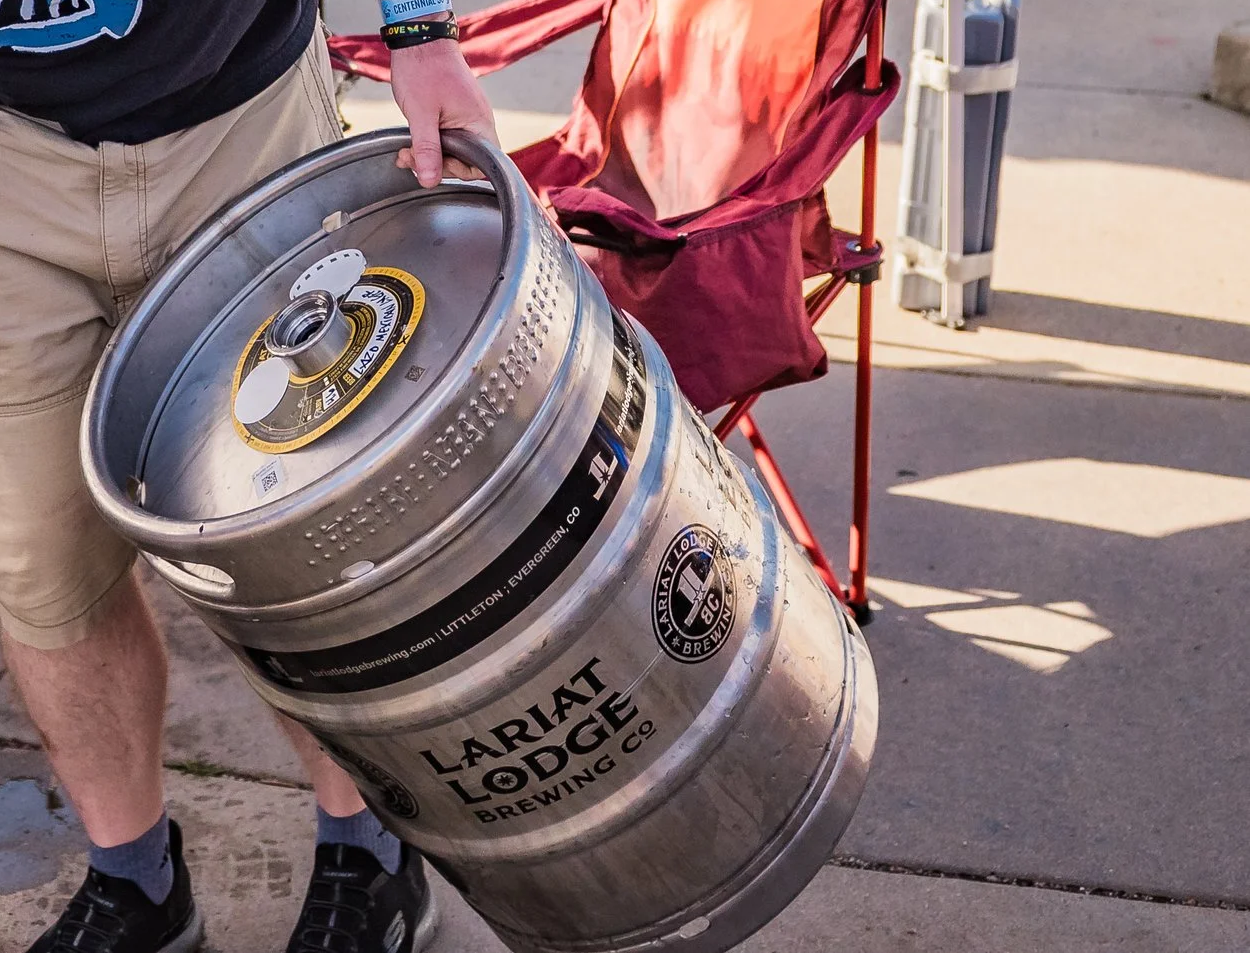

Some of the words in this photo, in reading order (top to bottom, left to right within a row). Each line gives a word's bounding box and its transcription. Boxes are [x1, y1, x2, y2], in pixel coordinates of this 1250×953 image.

[309, 634, 435, 678] lariatlodgebrewing.com
[440, 588, 504, 637] LITTLETON
[507, 524, 570, 589] EVERGREEN,
[565, 506, 581, 525] CO
[658, 560, 676, 638] LARIAT
[673, 530, 716, 560] LODGE
[681, 594, 733, 655] BREWING
[418, 656, 607, 775] LARIAT
[445, 690, 640, 805] LODGE
[472, 754, 617, 824] BREWING
